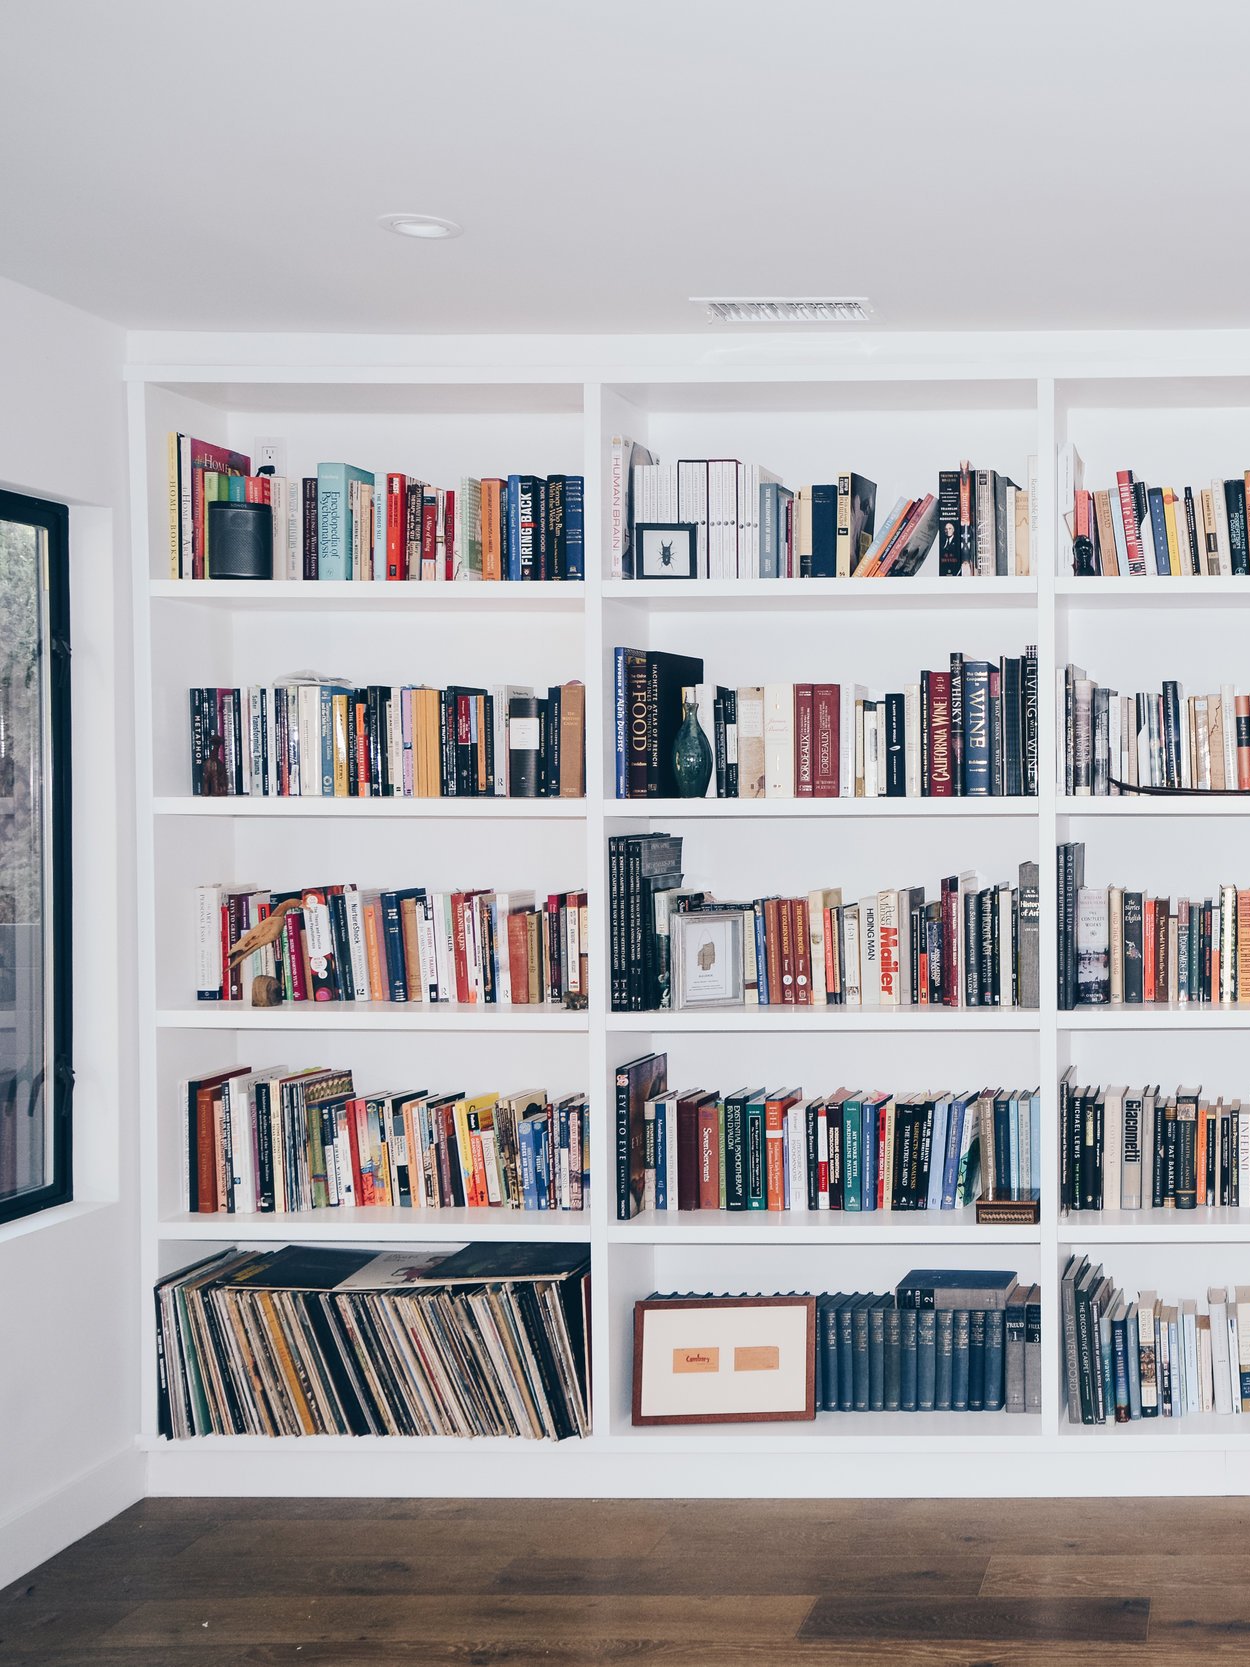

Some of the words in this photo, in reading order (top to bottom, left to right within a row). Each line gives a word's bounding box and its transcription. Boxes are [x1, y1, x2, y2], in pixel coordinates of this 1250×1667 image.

[555, 482, 563, 506] Women
[613, 458, 621, 506] HUMAN
[320, 491, 331, 558] Psychoanalysis
[328, 491, 341, 546] Encyclopedia
[521, 493, 532, 522] BACK
[555, 507, 563, 521] Who
[960, 493, 969, 522] butterfly
[521, 528, 532, 565] FIRING
[555, 522, 563, 537] Run
[613, 509, 621, 549] BRAIN
[331, 549, 341, 559] of
[951, 676, 961, 724] WHISKY
[1028, 666, 1037, 717] LIVING
[632, 691, 647, 751] FOOD
[931, 702, 948, 726] WINE
[970, 688, 986, 748] WINE
[252, 715, 260, 753] Transforming
[652, 729, 658, 737] OF
[932, 728, 949, 781] CALIFORNIA
[1028, 738, 1037, 781] WINE
[350, 903, 360, 944] NurtureShock
[867, 908, 875, 938] HIDING
[880, 895, 890, 925] Manso
[884, 906, 895, 925] Peter
[457, 932, 466, 951] KLEIN
[867, 939, 875, 961] MAN
[880, 926, 898, 995] Mailer
[619, 1120, 626, 1135] TO
[1125, 1100, 1141, 1162] Giacometti
[1240, 1121, 1249, 1170] INFERNO
[484, 1137, 493, 1166] Fossils
[733, 1145, 742, 1196] PSYCHOTHERAPY
[1066, 1314, 1074, 1334] AXEL
[1068, 1338, 1077, 1395] VERVOORDT
